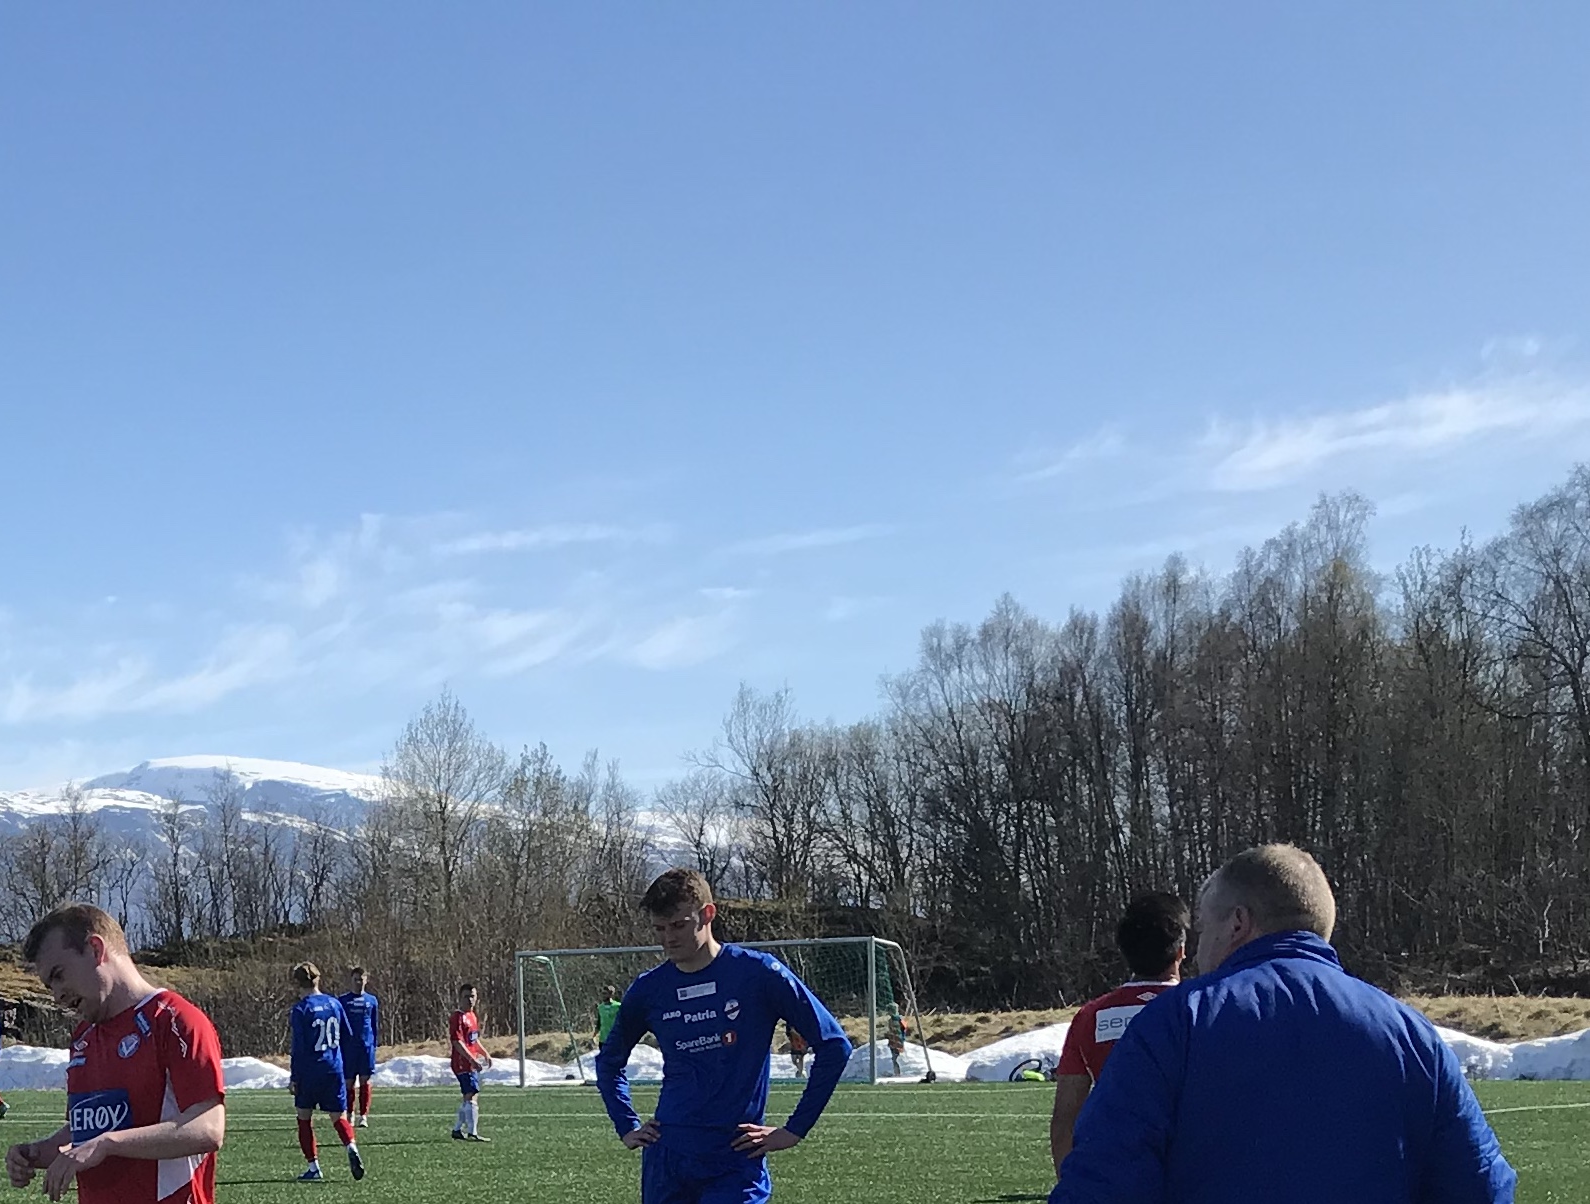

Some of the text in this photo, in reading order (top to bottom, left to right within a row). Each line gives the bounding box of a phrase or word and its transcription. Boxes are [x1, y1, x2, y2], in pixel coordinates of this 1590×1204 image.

[683, 1009, 717, 1024] Patria
[311, 1016, 341, 1052] 20
[675, 1032, 722, 1051] SpareBank
